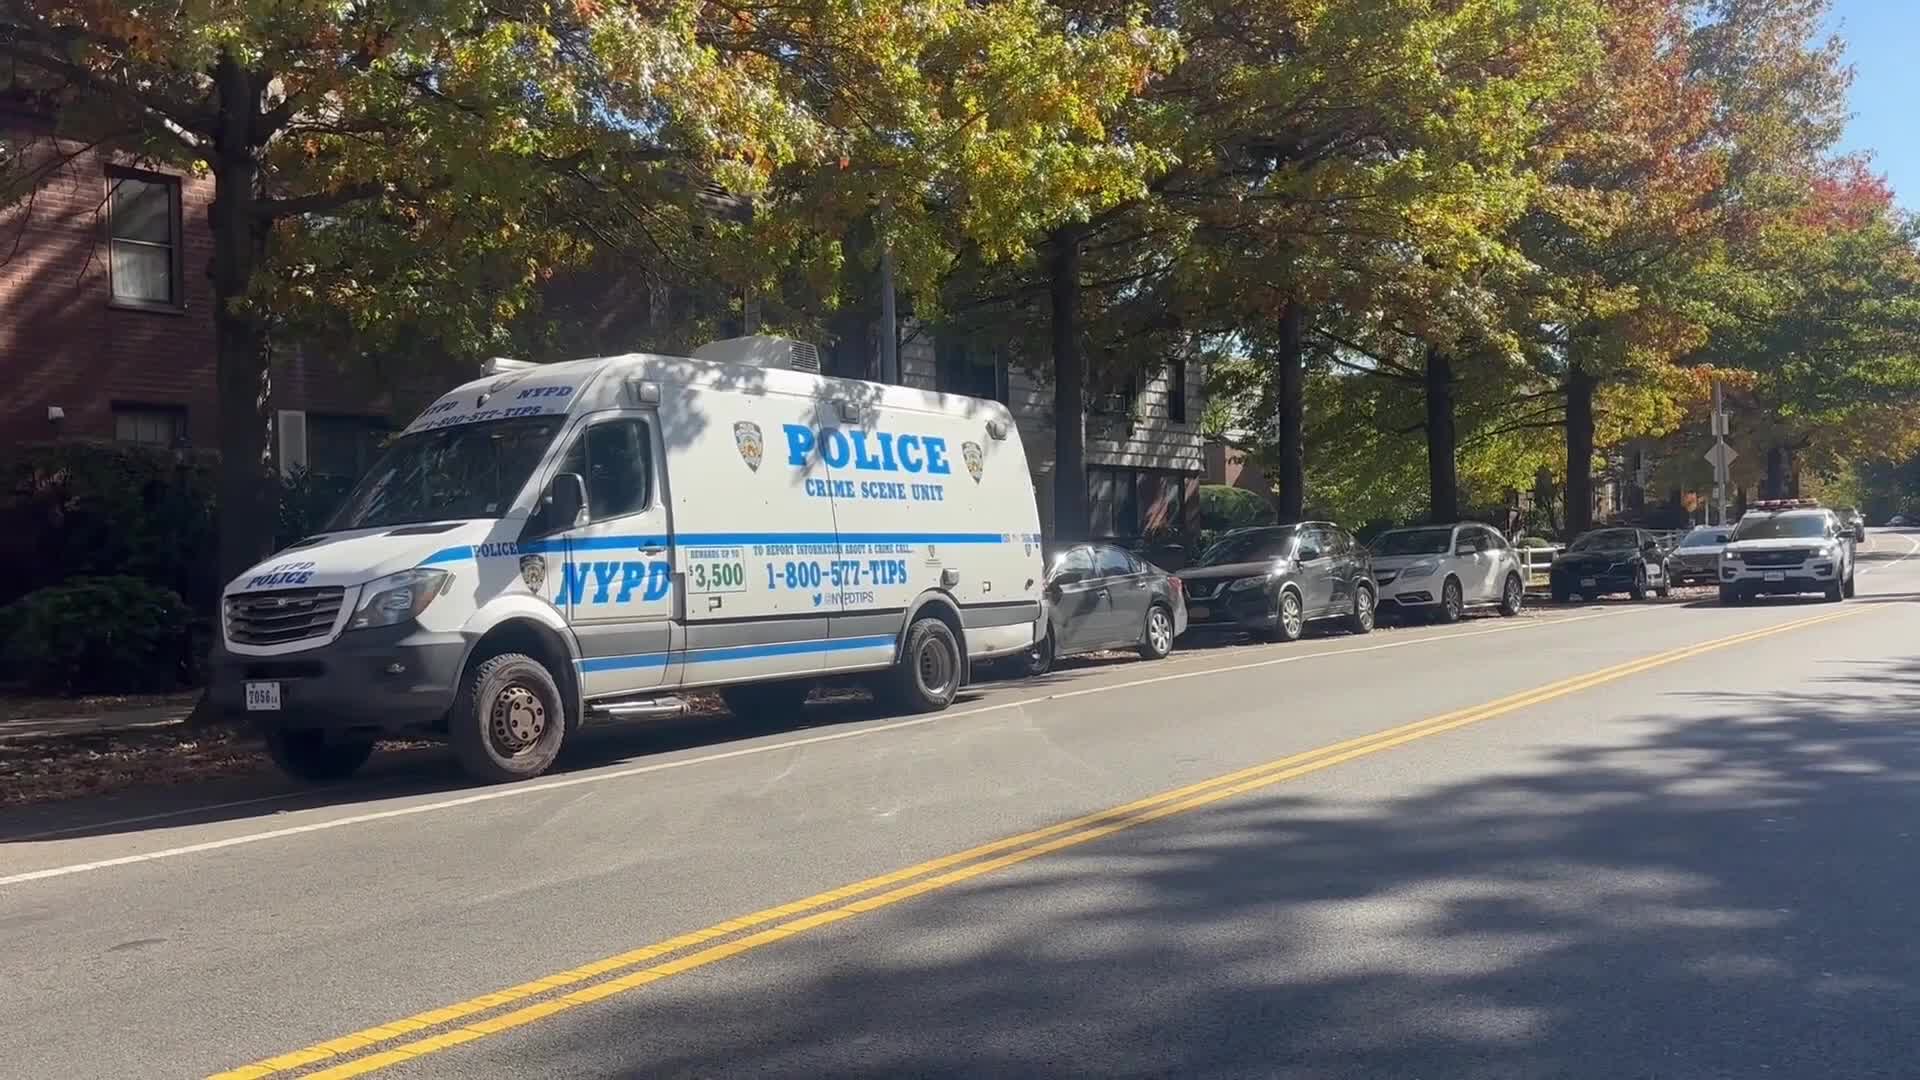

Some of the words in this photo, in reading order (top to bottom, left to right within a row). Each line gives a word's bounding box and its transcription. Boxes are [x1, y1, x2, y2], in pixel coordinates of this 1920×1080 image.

[516, 386, 573, 399] NYPD
[427, 406, 542, 428] 1-800-577-TIPS
[783, 424, 951, 474] POLICE
[806, 478, 856, 498] CRIME
[861, 480, 907, 500] SCENE
[912, 484, 944, 501] UNIT
[472, 543, 518, 557] POLICE
[753, 545, 763, 556] TO
[766, 545, 793, 555] REPORT
[796, 544, 842, 554] INFORMATION
[845, 544, 865, 553] ABOUT
[874, 544, 893, 553] CRIME
[246, 571, 314, 588] POLICE
[555, 561, 671, 605] NYPD
[689, 563, 744, 590] $3,500
[767, 560, 907, 589] 1-800-577-TIPS
